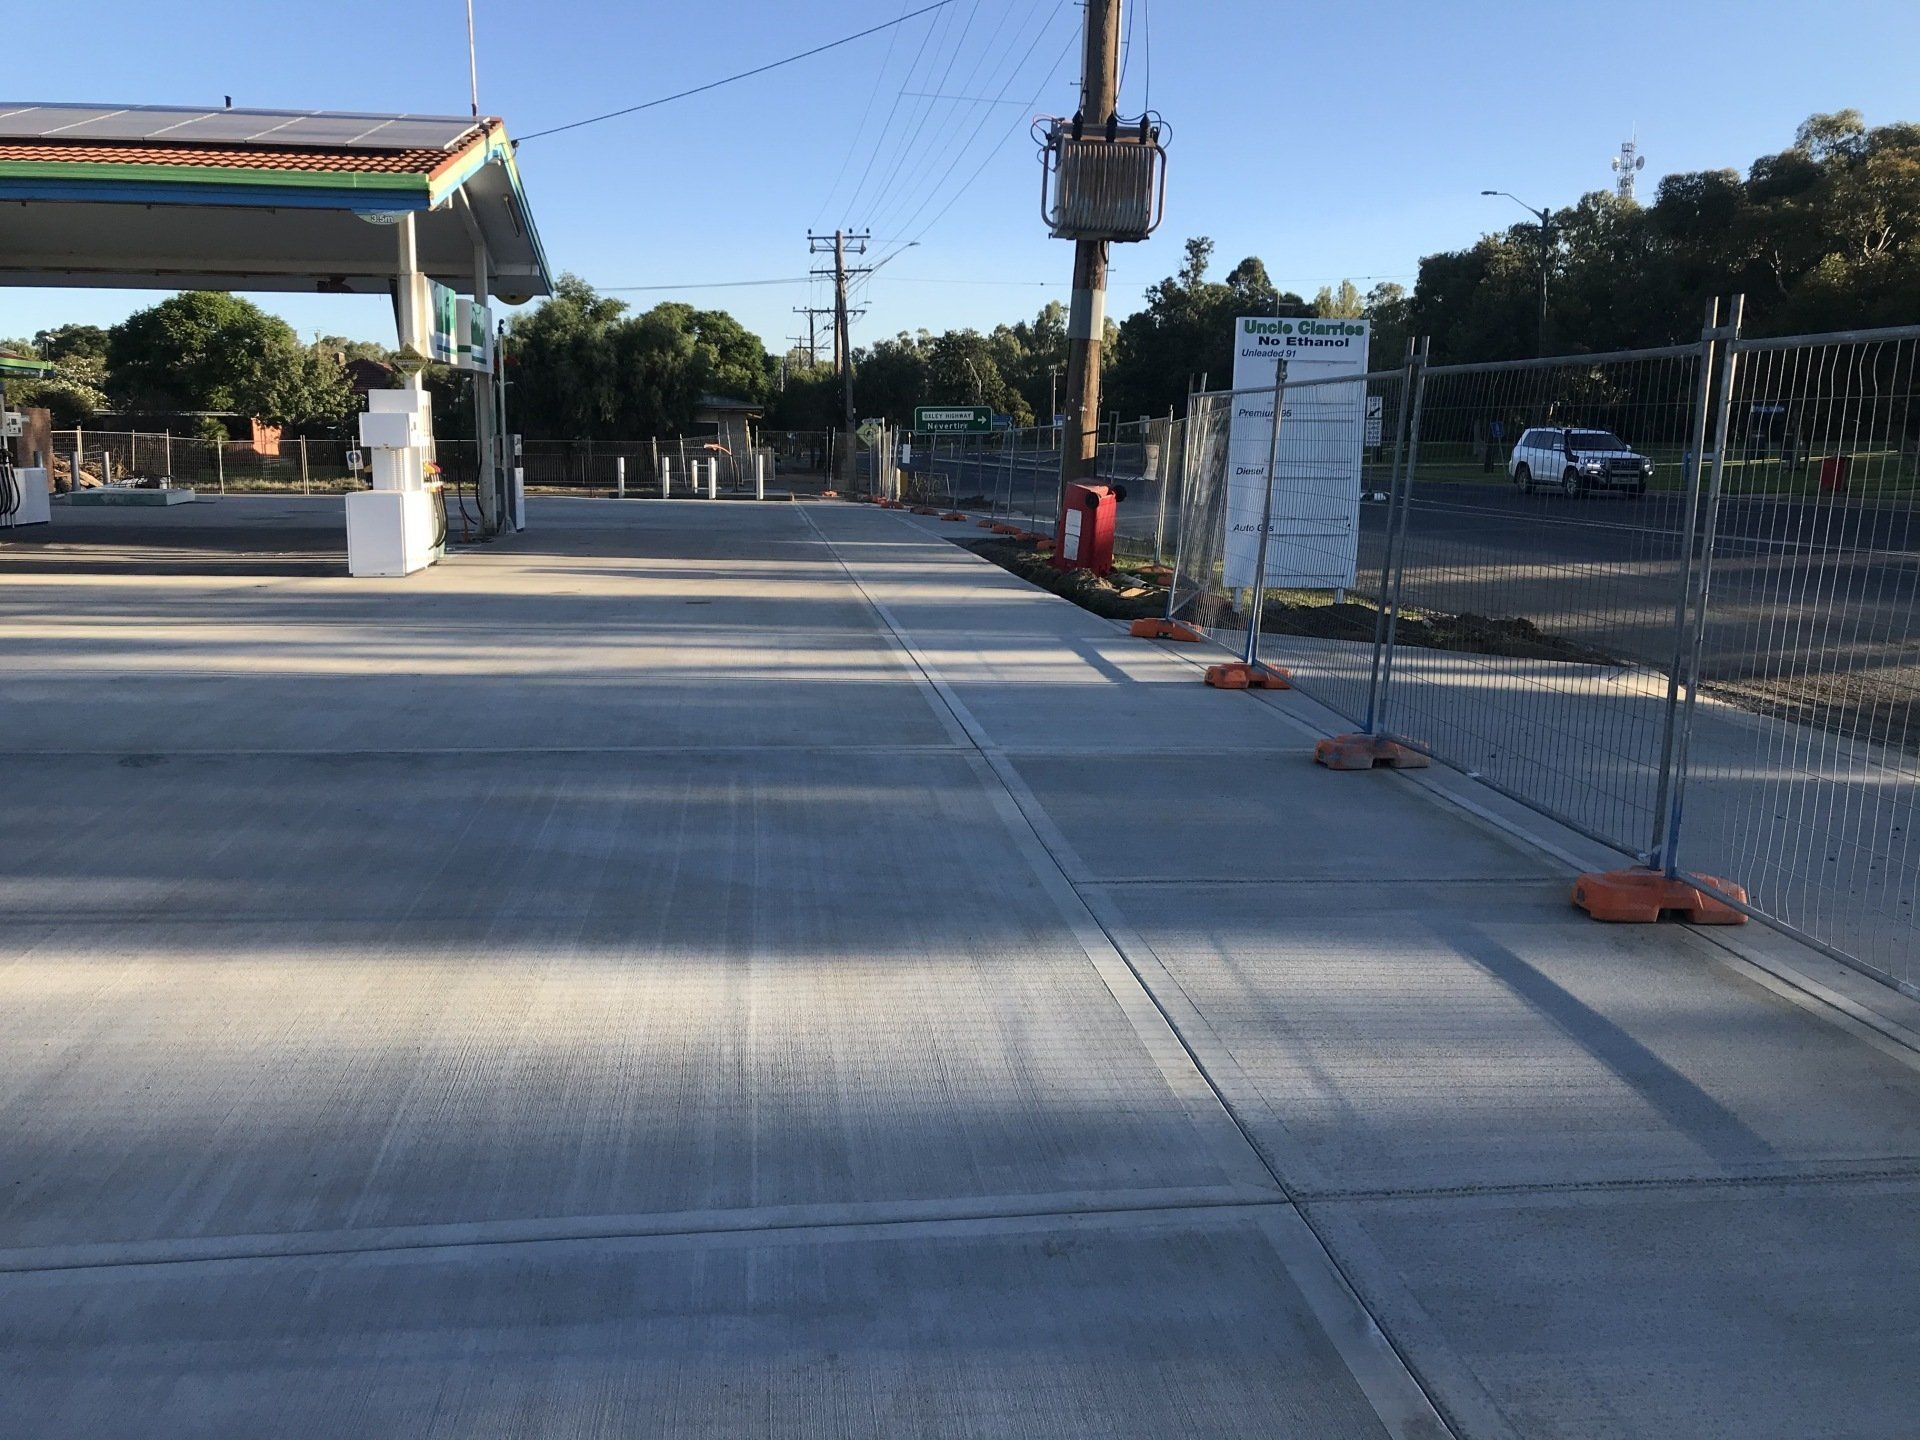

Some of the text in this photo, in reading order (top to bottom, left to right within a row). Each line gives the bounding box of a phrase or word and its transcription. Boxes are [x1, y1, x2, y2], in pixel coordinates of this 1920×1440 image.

[371, 214, 394, 223] 3.5m
[1244, 319, 1365, 336] Uncle Clarries
[1258, 336, 1350, 348] No Ethanol
[1241, 349, 1297, 358] Unleaded 91
[1238, 408, 1293, 418] Premiu 95
[1235, 466, 1264, 476] Diesel
[1233, 523, 1275, 532] Auto Gs
